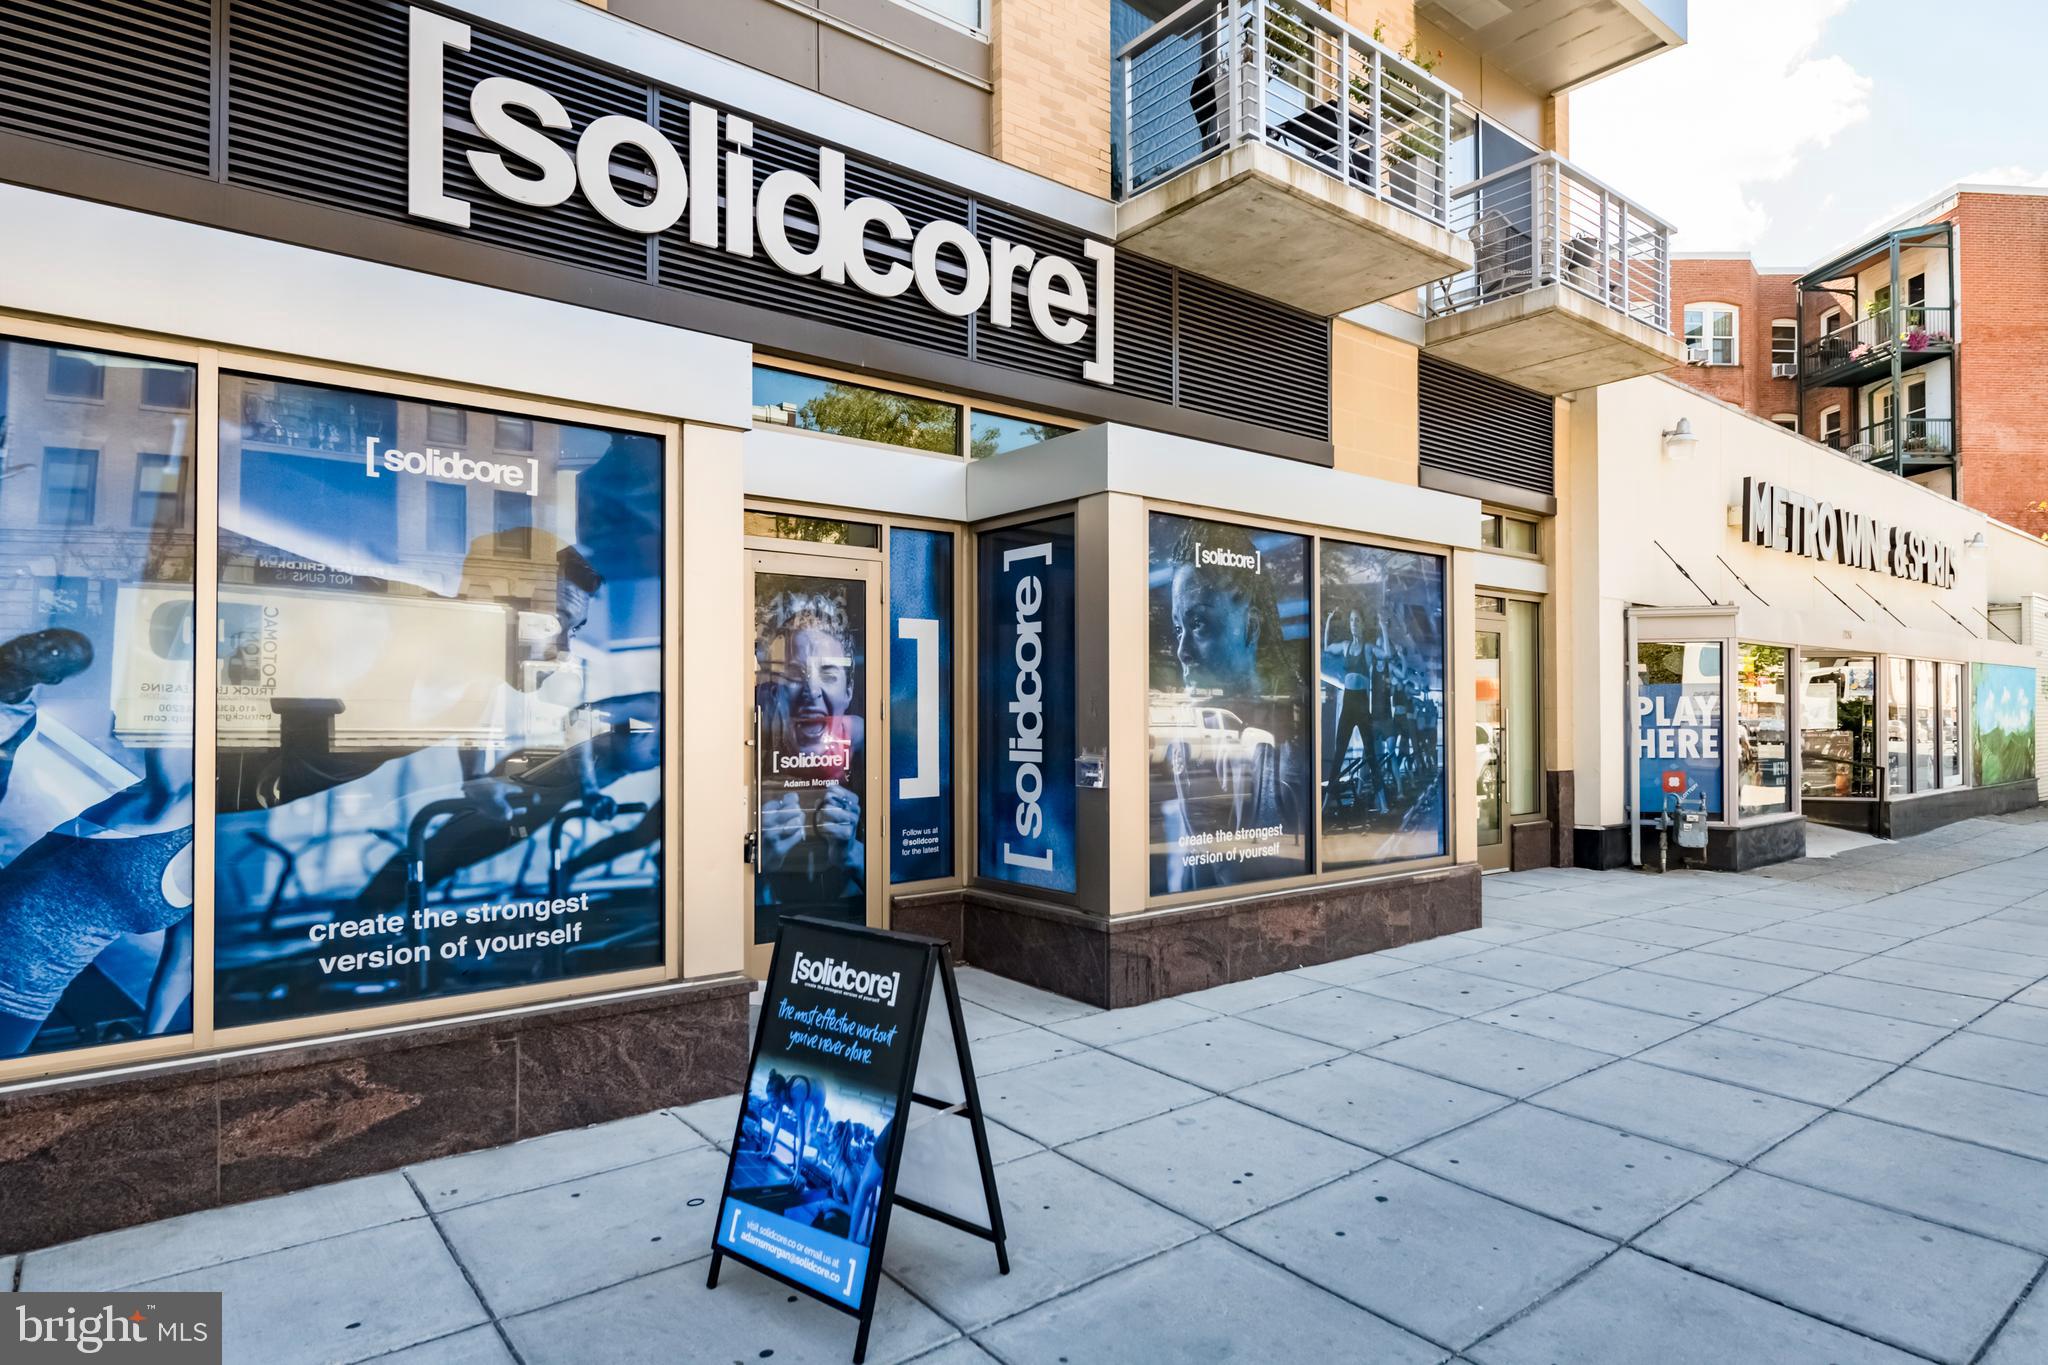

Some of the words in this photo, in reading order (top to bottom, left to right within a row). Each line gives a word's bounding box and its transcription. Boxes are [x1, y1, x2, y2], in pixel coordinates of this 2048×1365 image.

[1742, 476, 1838, 562] METRO
[1638, 695, 1720, 727] PLAY
[1638, 728, 1719, 759] HERE
[783, 779, 810, 788] Adams
[811, 778, 840, 788] Morgan
[902, 828, 922, 837] Follow
[923, 828, 932, 836] us
[933, 826, 939, 835] at
[902, 836, 939, 847] @solidcore
[1178, 831, 1214, 848] create
[1215, 829, 1233, 843] the
[1235, 823, 1284, 841] strongest
[901, 848, 910, 857] for
[911, 847, 922, 855] the
[922, 845, 939, 854] latest
[1182, 850, 1223, 867] version
[1225, 847, 1237, 862] of
[1239, 841, 1281, 863] yourself
[308, 913, 405, 943] create
[412, 907, 458, 930] the
[465, 892, 589, 925] strongest
[318, 944, 431, 975] version
[439, 935, 469, 960] of
[475, 921, 582, 960] yourself
[793, 1004, 819, 1026] most
[815, 1007, 857, 1036] effective
[855, 1023, 899, 1047] workout
[785, 1027, 819, 1051] you've
[817, 1035, 847, 1056] never
[746, 1220, 760, 1233] visit
[759, 1225, 796, 1249] solidcore.co
[795, 1243, 804, 1253] or
[803, 1244, 823, 1264] email
[822, 1254, 832, 1266] us
[831, 1257, 841, 1269] at
